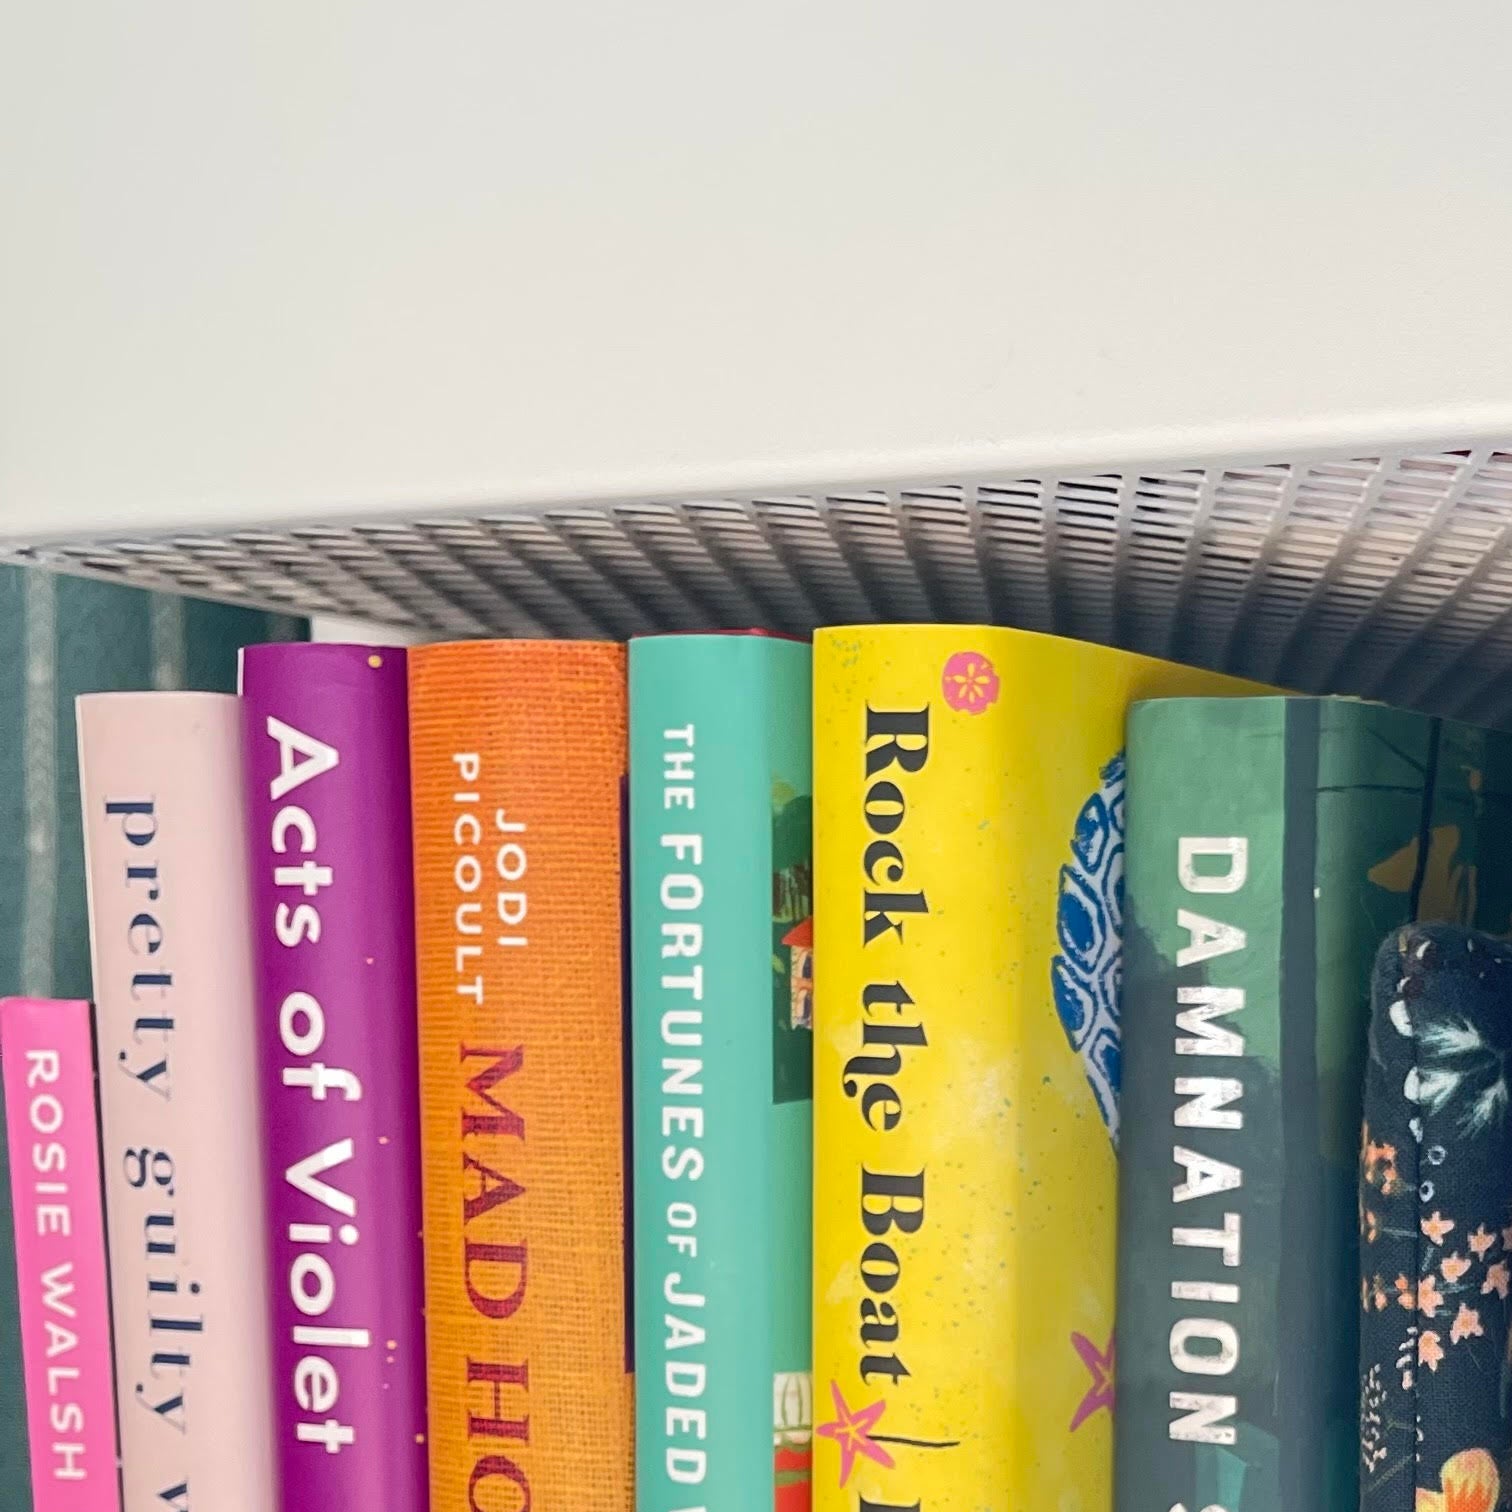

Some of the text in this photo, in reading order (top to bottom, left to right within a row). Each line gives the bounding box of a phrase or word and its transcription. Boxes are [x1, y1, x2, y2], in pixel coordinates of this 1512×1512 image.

[453, 752, 485, 1005] PICOULT
[496, 807, 529, 947] JODI
[662, 722, 696, 811] THE
[104, 795, 176, 1101] pretty
[659, 832, 705, 1182] FORTUNES
[842, 701, 930, 1387] Rock the Boat
[25, 1049, 71, 1236] ROSIE
[266, 715, 371, 1454] Acts of Violet
[459, 1041, 530, 1320] MAD
[1168, 834, 1250, 1446] DAMNATION
[122, 1146, 204, 1434] guilty
[666, 1201, 698, 1259] OF
[40, 1262, 87, 1480] WALSH
[662, 1271, 708, 1485] JADED
